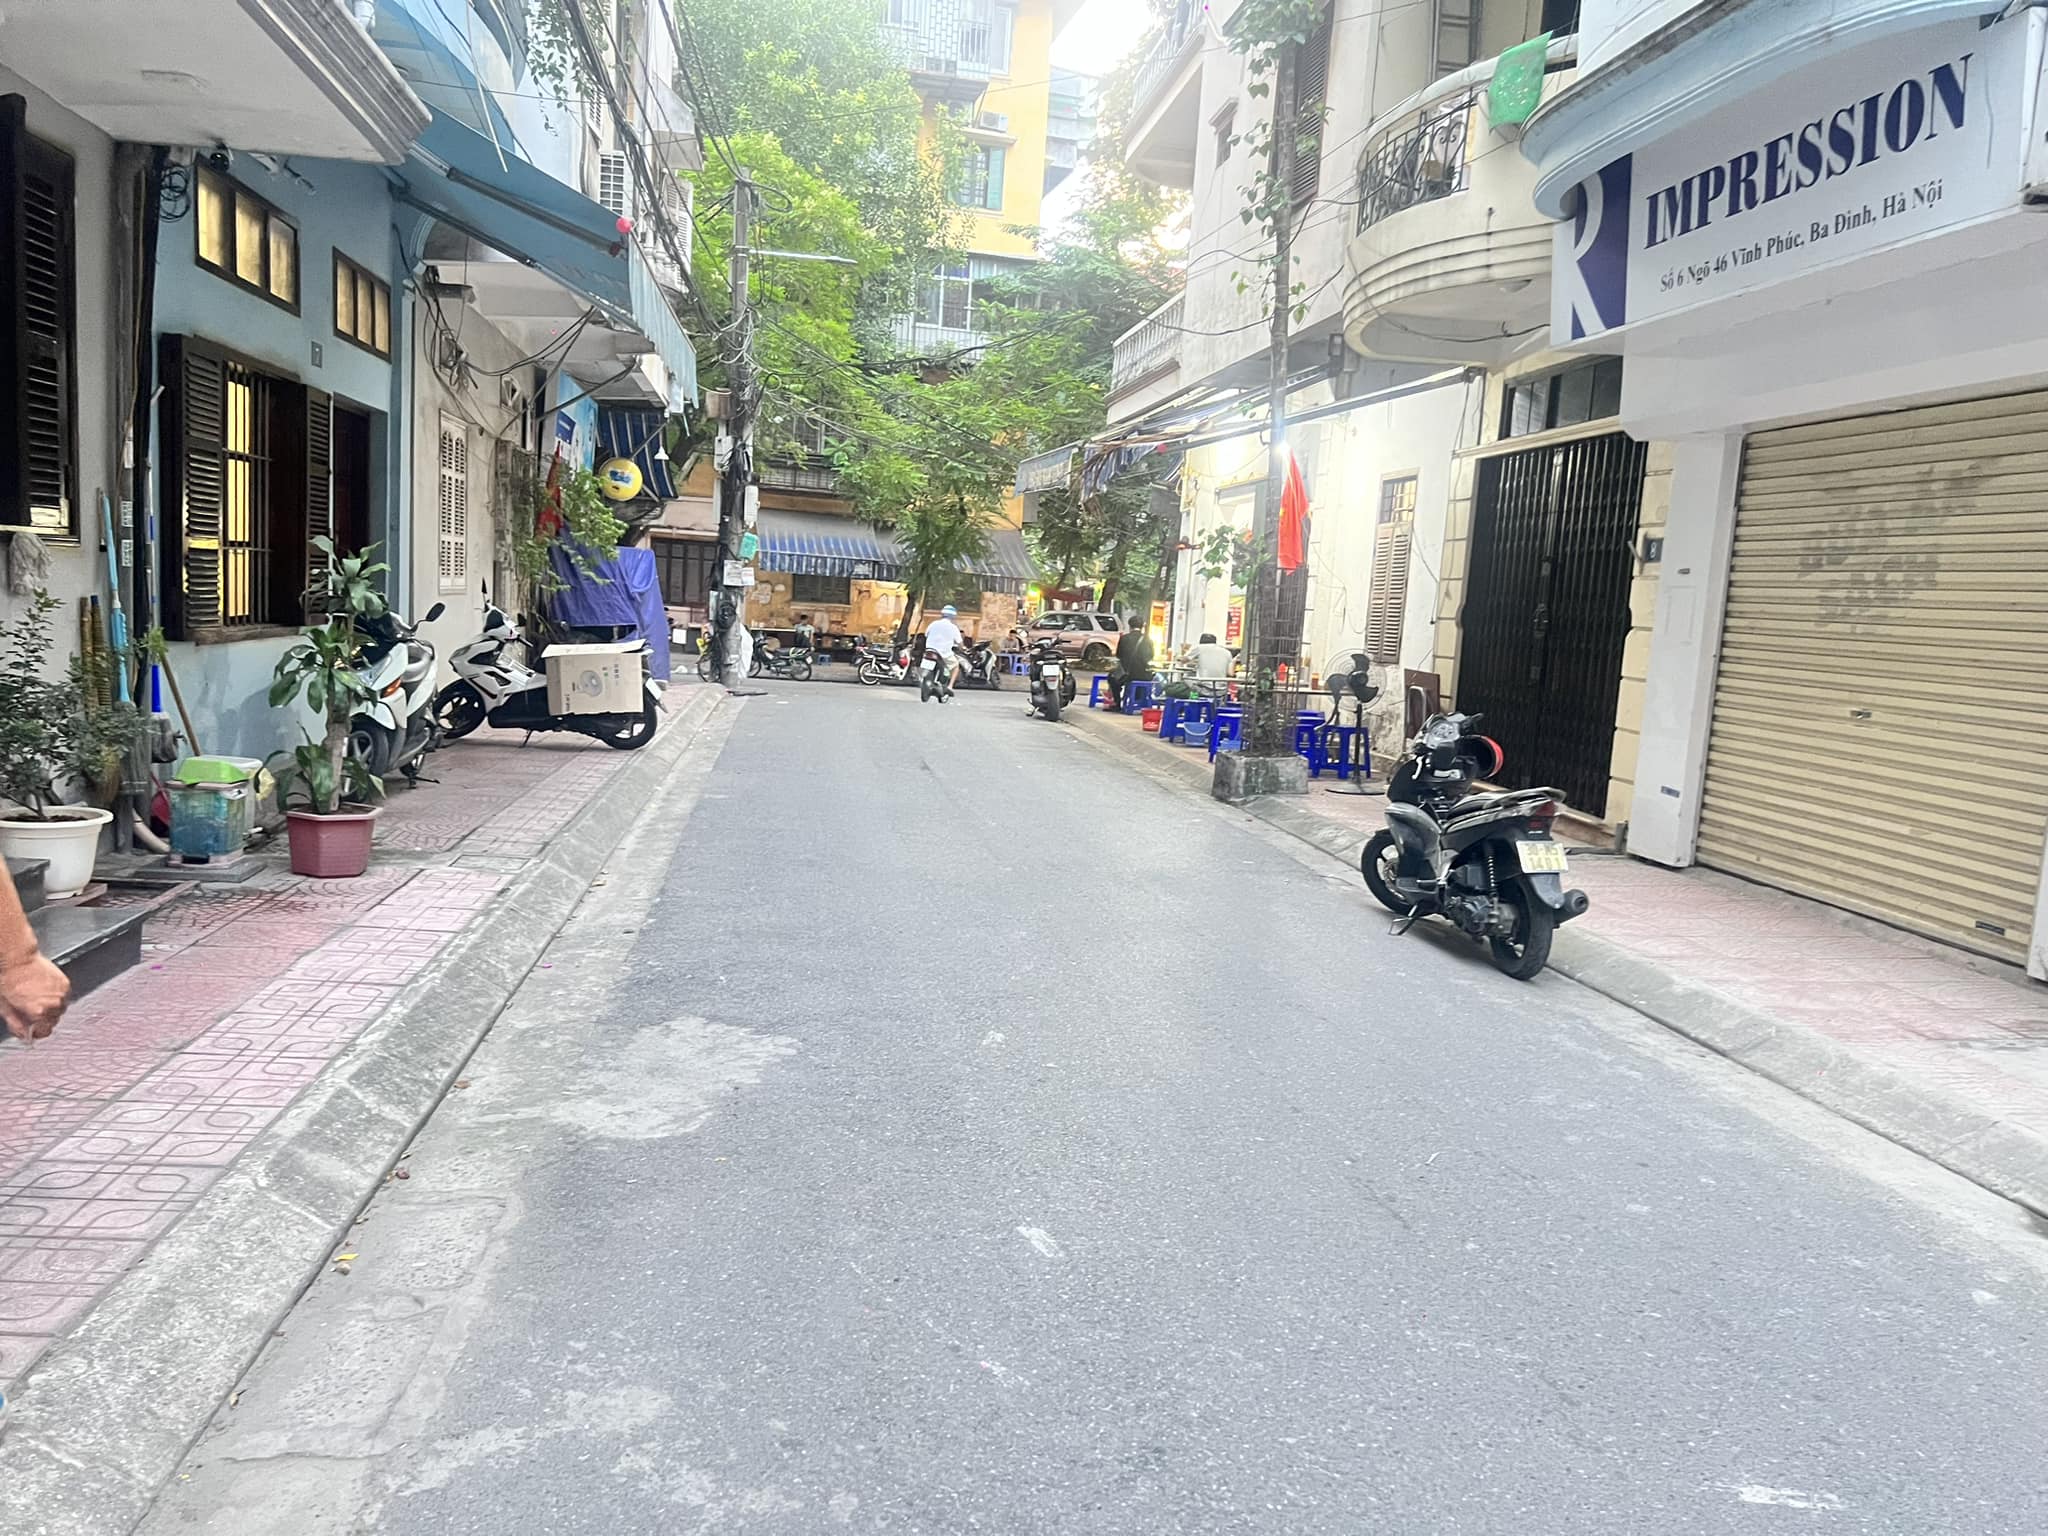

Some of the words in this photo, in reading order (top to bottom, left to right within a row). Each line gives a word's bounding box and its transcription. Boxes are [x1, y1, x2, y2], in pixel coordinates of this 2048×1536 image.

[1644, 53, 1974, 250] IMPRESSION
[1659, 265, 1675, 293] Số
[1676, 269, 1684, 287] 6
[1686, 260, 1711, 286] Ngõ
[1713, 253, 1728, 274] 46
[1809, 222, 1829, 243] Ba
[1911, 178, 1943, 209] Nội
